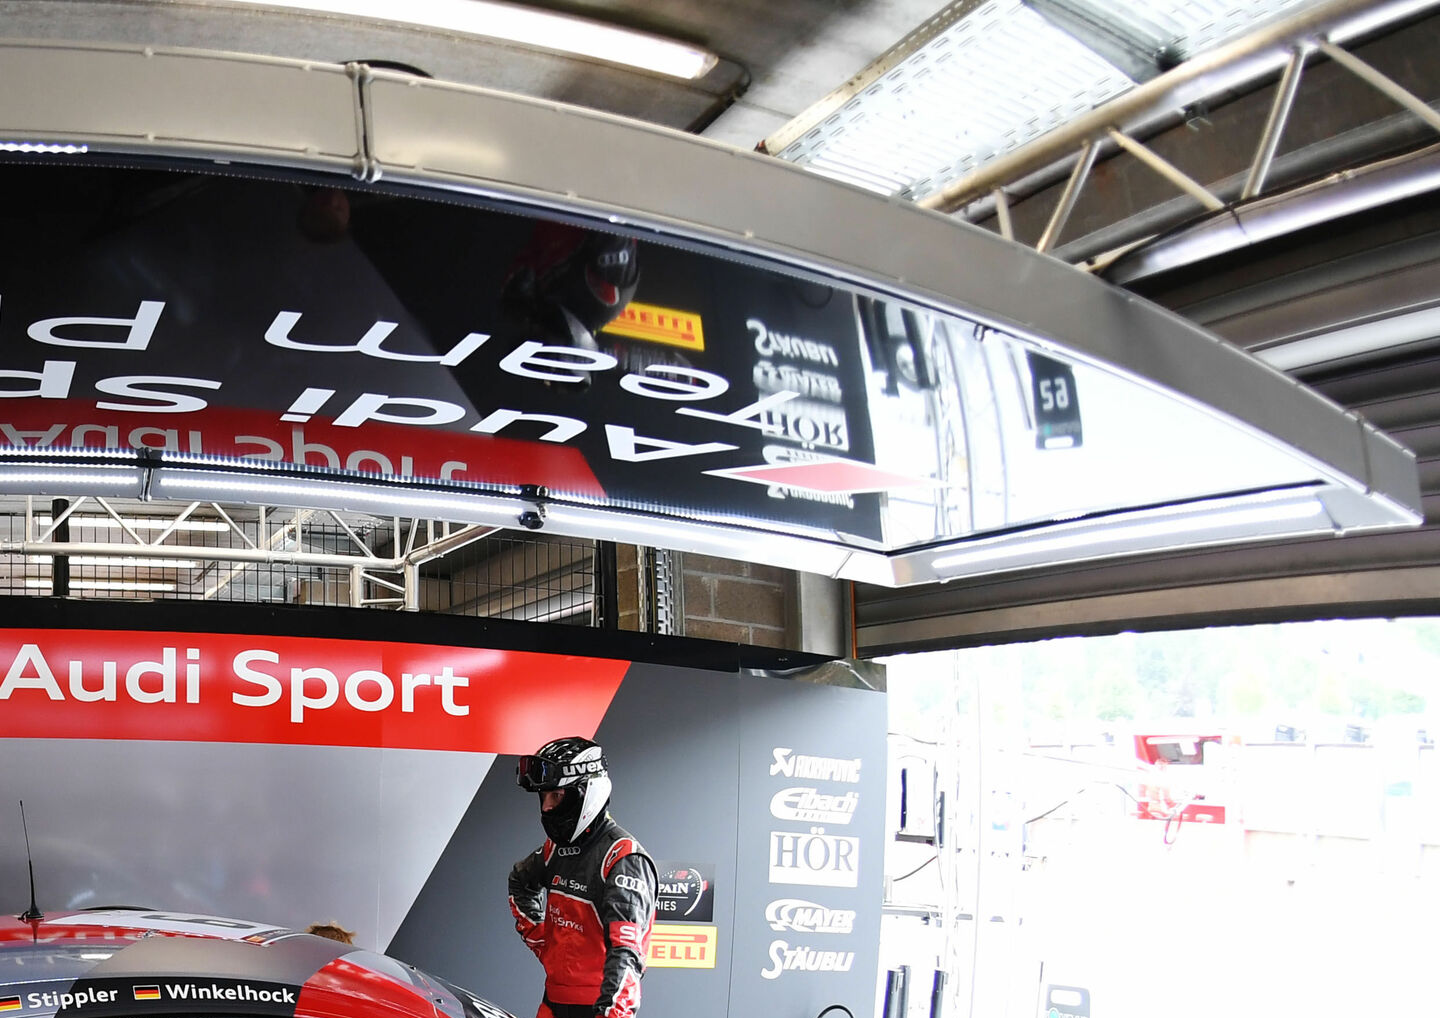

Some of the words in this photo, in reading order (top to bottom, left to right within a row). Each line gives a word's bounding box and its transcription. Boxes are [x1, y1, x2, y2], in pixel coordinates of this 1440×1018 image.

[264, 311, 801, 430] Team
[280, 388, 739, 463] Audi
[232, 649, 470, 724] Sport
[562, 760, 604, 776] uvex
[773, 826, 854, 872] HÖR
[651, 944, 706, 961] ELLI
[760, 939, 856, 980] STÄUBLI
[26, 985, 118, 1012] Stippler
[164, 983, 296, 1007] Winkelhock
